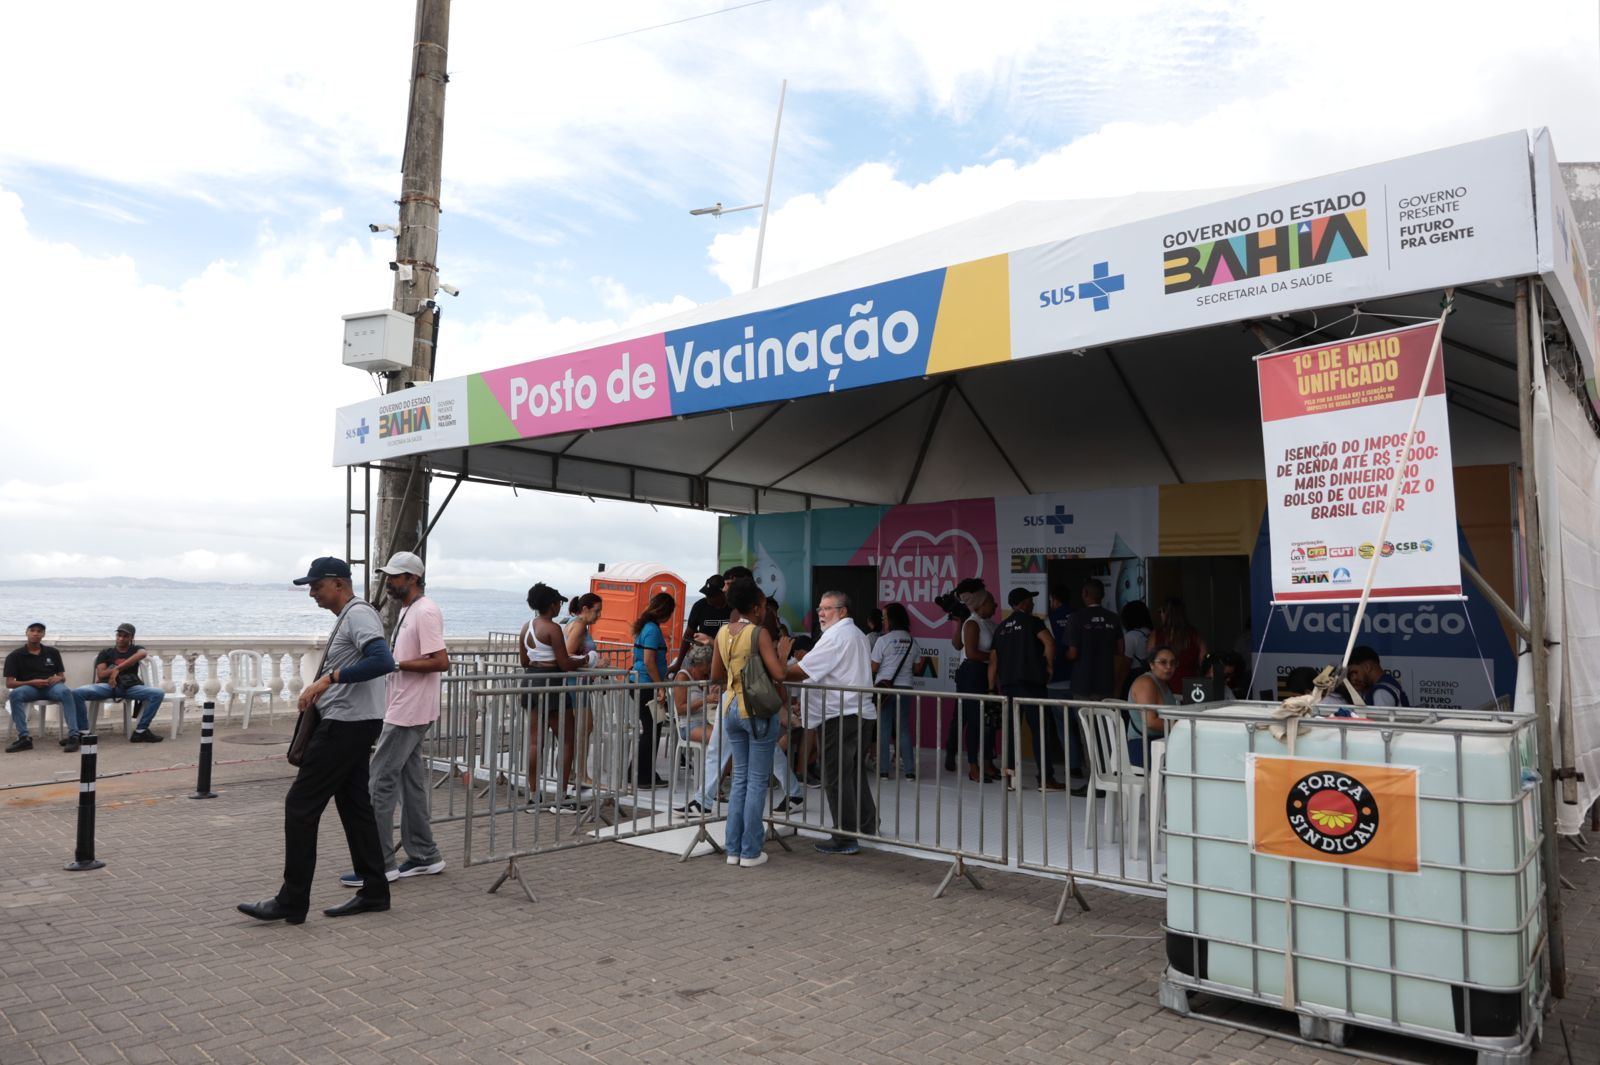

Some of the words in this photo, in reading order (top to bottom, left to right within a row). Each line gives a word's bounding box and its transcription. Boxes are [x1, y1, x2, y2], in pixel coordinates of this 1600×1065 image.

[1398, 186, 1467, 208] GOVERNO
[1163, 217, 1250, 249] GOVERNO
[1256, 209, 1284, 229] DO
[1290, 190, 1366, 221] ESTADO
[1400, 200, 1460, 222] PRESENTE
[1400, 218, 1454, 236] FUTURO
[1400, 236, 1427, 250] PRA
[1429, 226, 1474, 244] GENTE
[1163, 208, 1368, 295] BAHIA
[1039, 284, 1076, 308] SUS
[1196, 284, 1268, 306] SECRETARIA
[1271, 280, 1289, 294] DA
[1291, 271, 1333, 290] SAÚDE
[510, 367, 598, 421] Posto
[606, 352, 656, 404] de
[666, 300, 919, 393] Vacinação
[1318, 348, 1342, 371] DE
[1348, 336, 1400, 365] MAIO
[1298, 361, 1399, 396] UNIFICADO
[379, 401, 403, 414] GOVERNO
[403, 400, 411, 408] DO
[411, 396, 430, 406] ESTADO
[379, 406, 432, 439] BAHIA
[1284, 442, 1336, 461] ISENÇÃO
[1342, 440, 1360, 454] DO
[1276, 464, 1292, 478] DE
[1297, 458, 1338, 475] RENDA
[1342, 450, 1368, 470] ATÉ
[1372, 450, 1390, 466] R$
[1294, 475, 1326, 490] MAIS
[1330, 467, 1394, 486] DINHEIRO
[1284, 491, 1323, 507] BOLSO
[1327, 488, 1344, 502] DE
[1348, 484, 1388, 500] QUEM
[1398, 480, 1420, 495] AZ
[1425, 478, 1435, 492] O
[1023, 515, 1044, 526] SUS
[1311, 503, 1358, 519] BRASIL
[1362, 498, 1405, 515] GIRR
[1330, 548, 1353, 556] CUT
[1396, 542, 1418, 550] CSB
[1292, 574, 1330, 584] BAHIA
[1278, 604, 1466, 640] Vacinação
[1419, 680, 1459, 688] GOVERNO
[1298, 774, 1363, 802] FORÇA
[1290, 814, 1376, 851] SINDICAL
